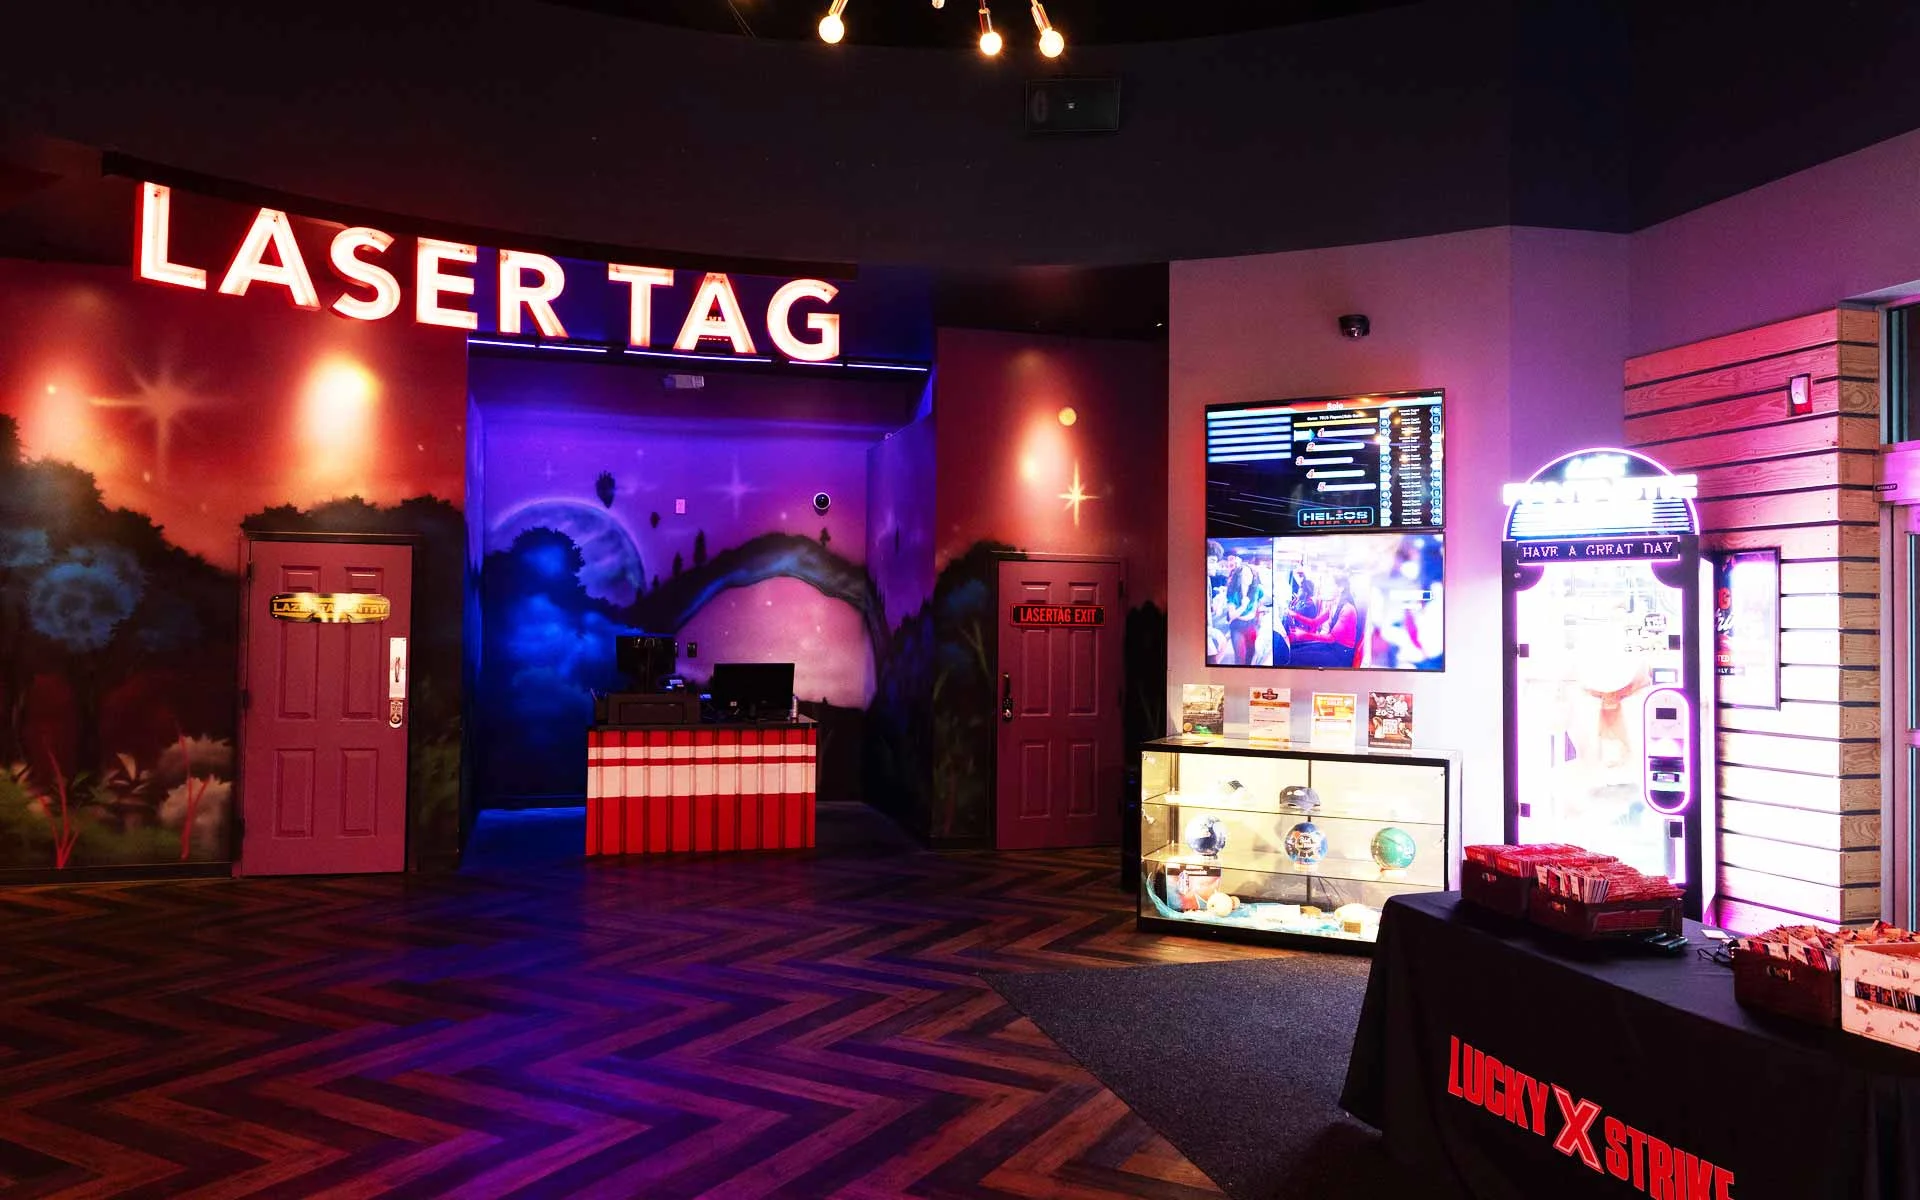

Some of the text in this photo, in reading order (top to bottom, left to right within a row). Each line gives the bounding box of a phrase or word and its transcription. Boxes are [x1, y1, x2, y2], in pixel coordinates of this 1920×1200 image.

[136, 181, 842, 363] LASER TAG
[1523, 542, 1673, 558] HAVE A GREAT DAY
[1020, 607, 1096, 622] LASERTAG EXIT
[1448, 1035, 1549, 1136] LUCKY
[1605, 1115, 1735, 1200] STRIKE
